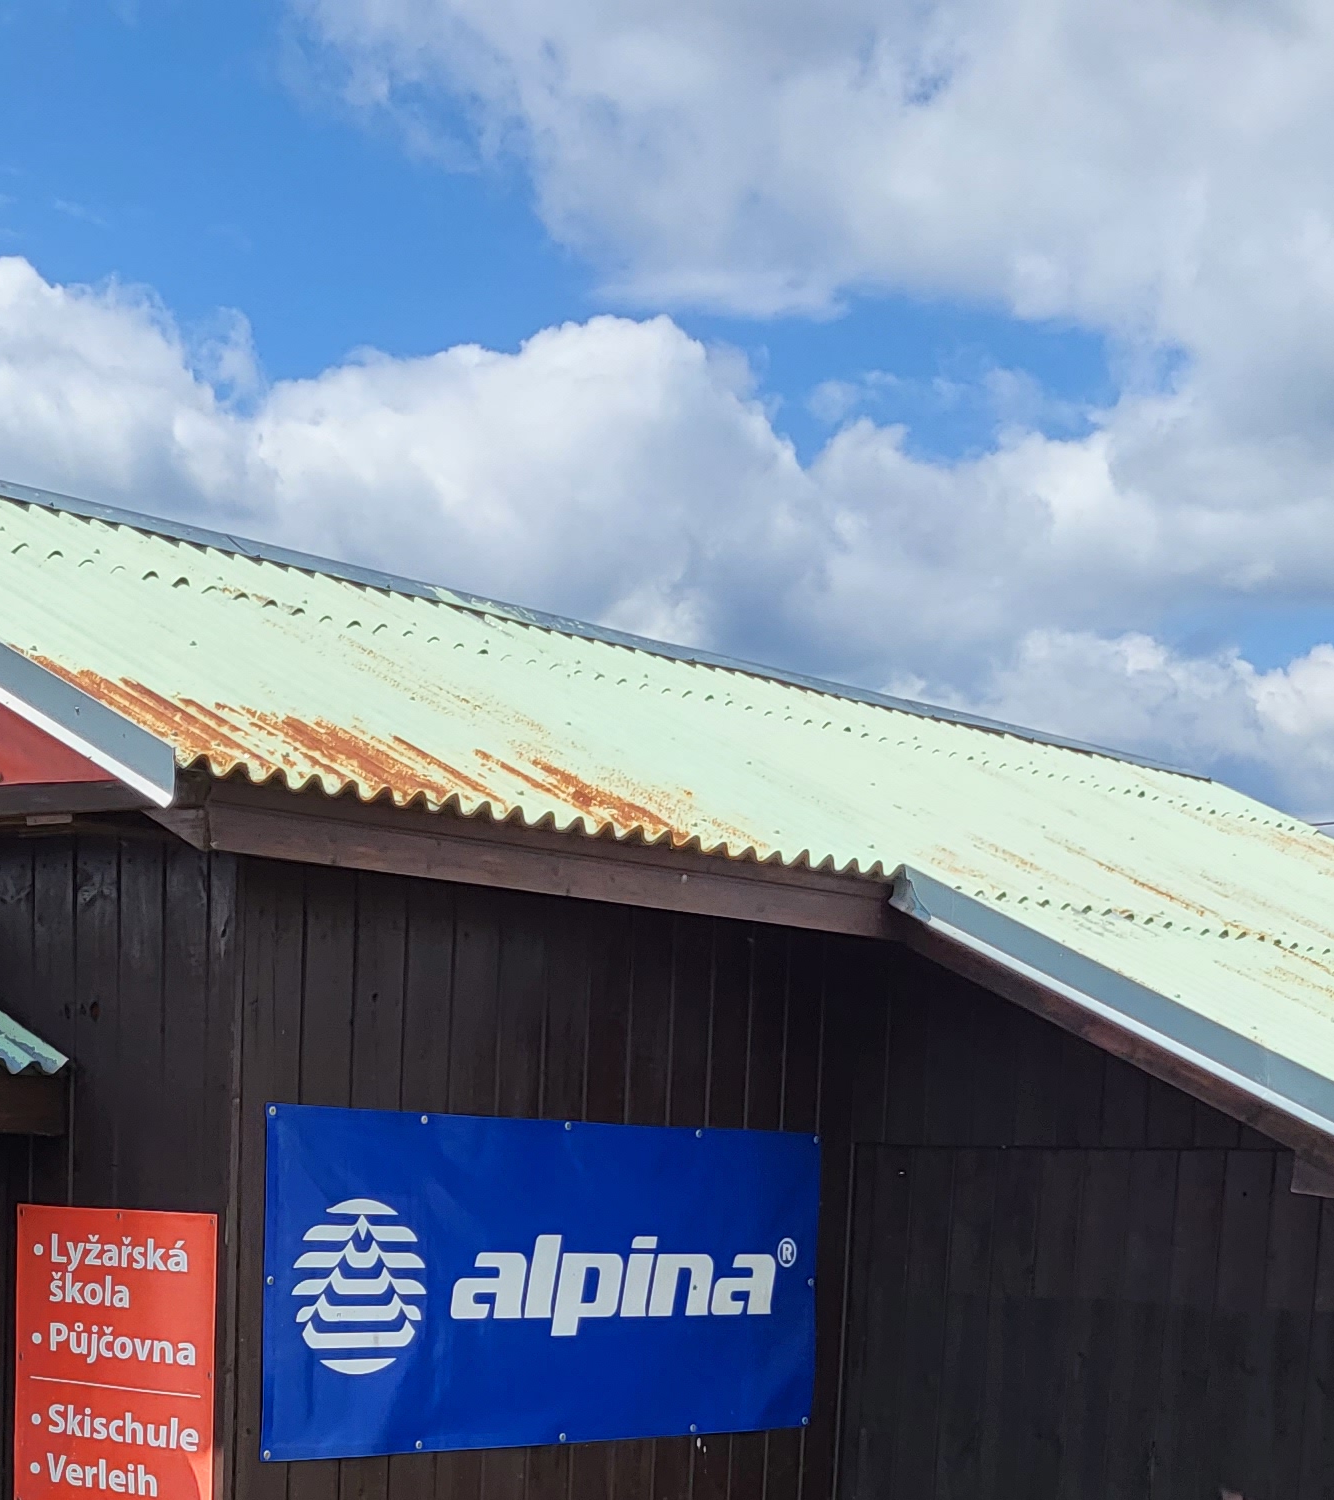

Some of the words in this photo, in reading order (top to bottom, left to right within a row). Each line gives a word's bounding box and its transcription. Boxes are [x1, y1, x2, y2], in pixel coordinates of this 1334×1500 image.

[49, 1233, 190, 1276] Lyžařská
[48, 1273, 131, 1311] škola
[48, 1322, 198, 1368] Půjčovna
[47, 1403, 200, 1453] Skischule
[47, 1453, 159, 1498] Verleih
